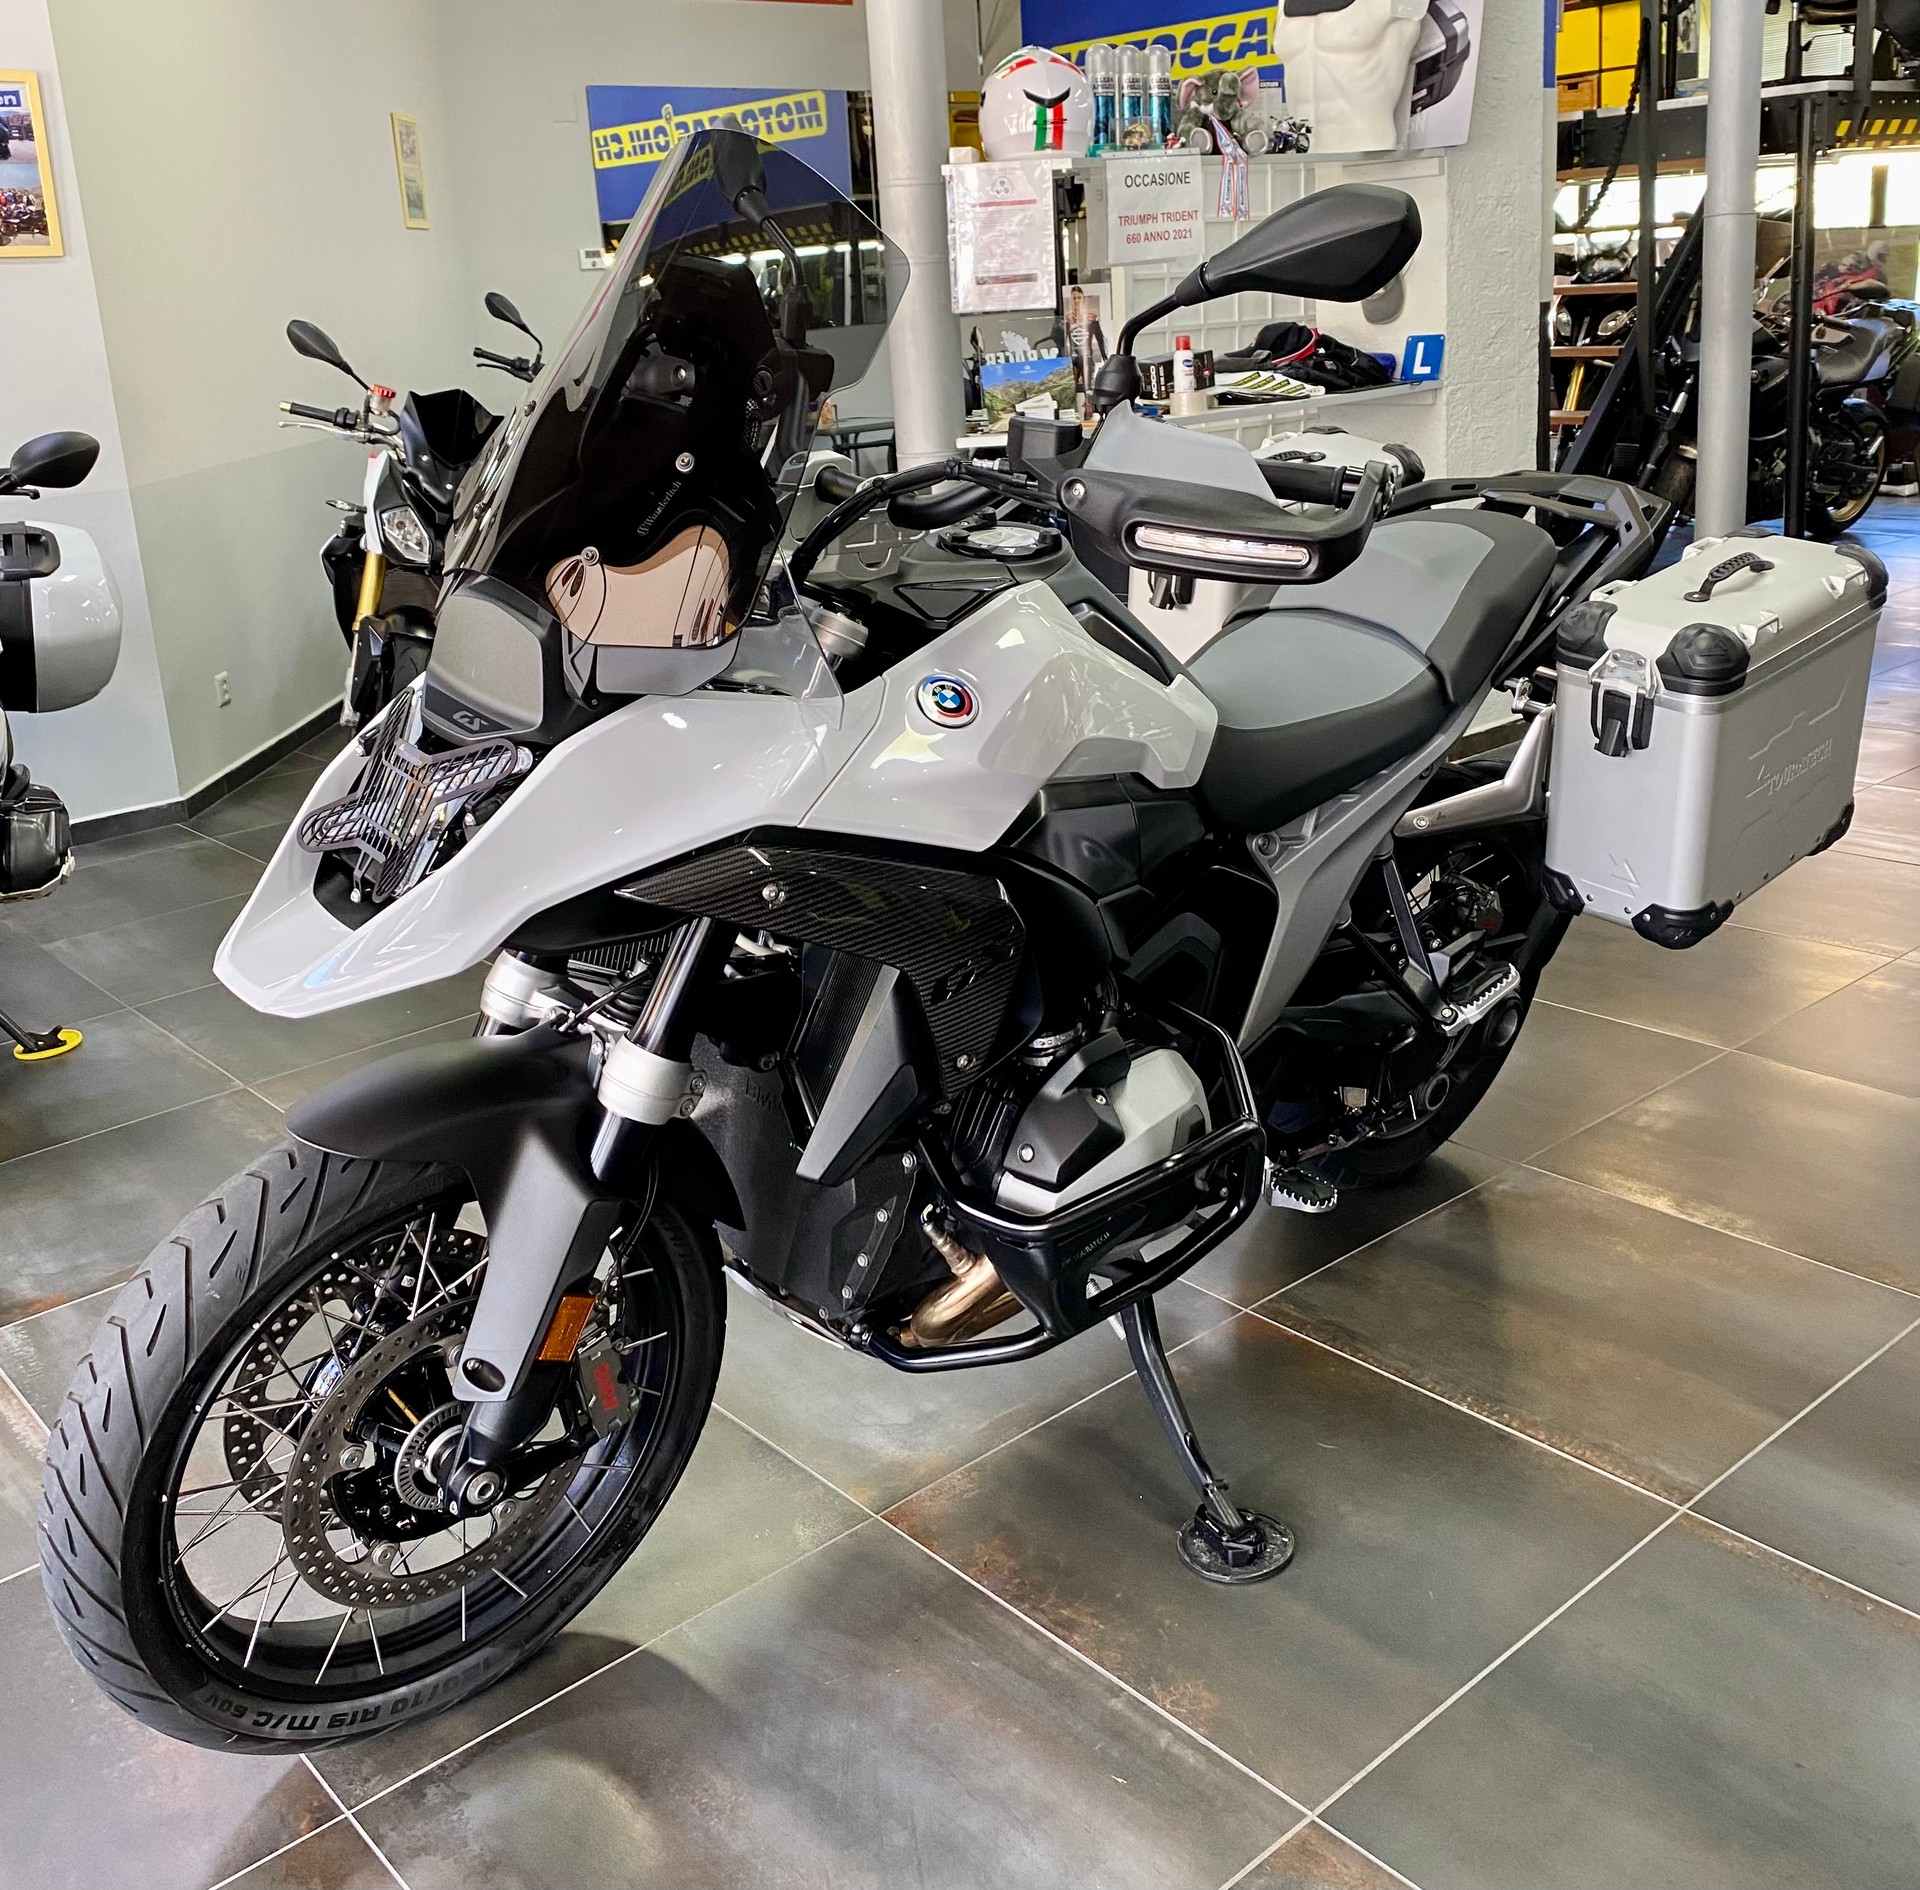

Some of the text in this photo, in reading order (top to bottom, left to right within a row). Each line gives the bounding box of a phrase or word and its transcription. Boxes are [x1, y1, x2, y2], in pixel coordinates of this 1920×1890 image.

[1124, 171, 1191, 188] OCCASIONE
[1118, 209, 1199, 227] TRIUMPH TRIDENT
[1126, 228, 1193, 245] 660 ANNO 2021
[1413, 341, 1431, 374] L
[1150, 365, 1159, 399] NOCO
[643, 481, 682, 527] Wunderlich
[453, 710, 489, 731] GS
[204, 1692, 250, 1719] 60V
[326, 1704, 382, 1729] R19
[253, 1711, 320, 1732] M/C
